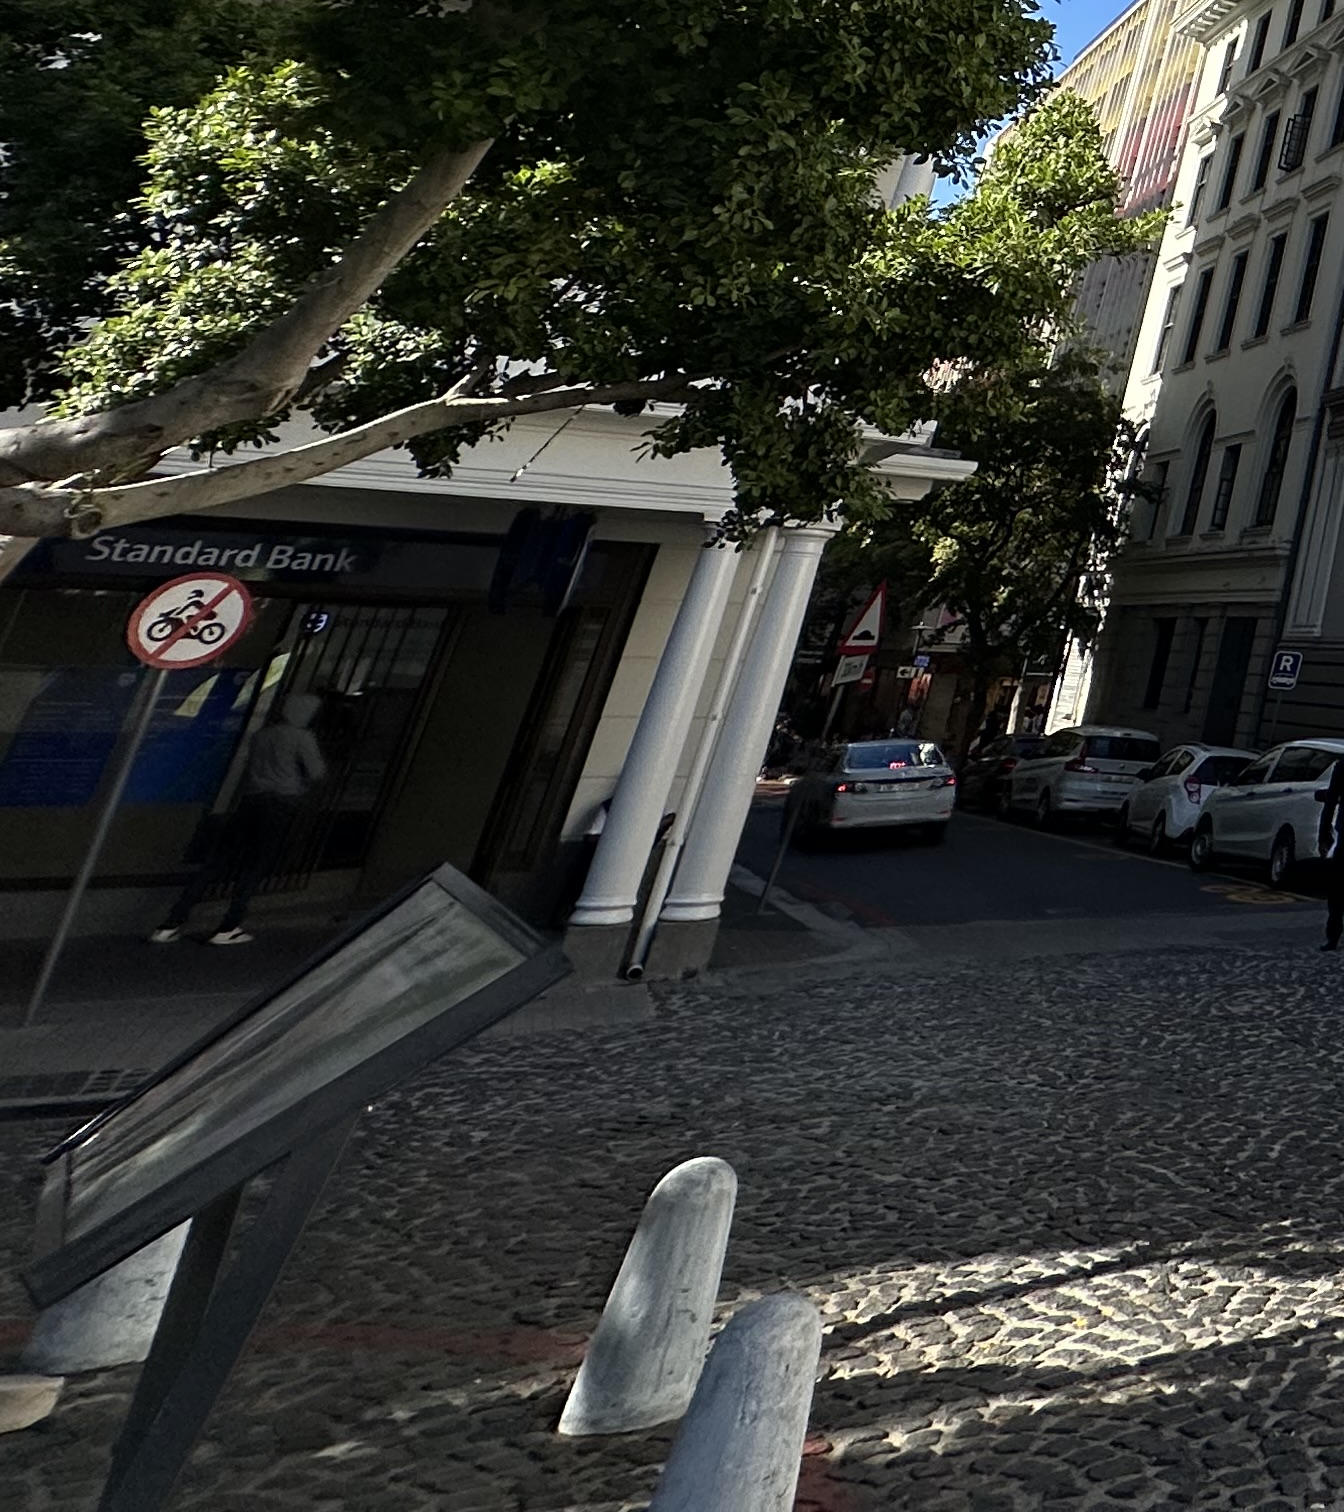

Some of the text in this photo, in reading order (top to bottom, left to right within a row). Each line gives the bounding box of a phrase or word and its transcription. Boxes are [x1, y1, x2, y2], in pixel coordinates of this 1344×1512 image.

[85, 535, 358, 574] Standard Bank
[1279, 654, 1294, 672] R
